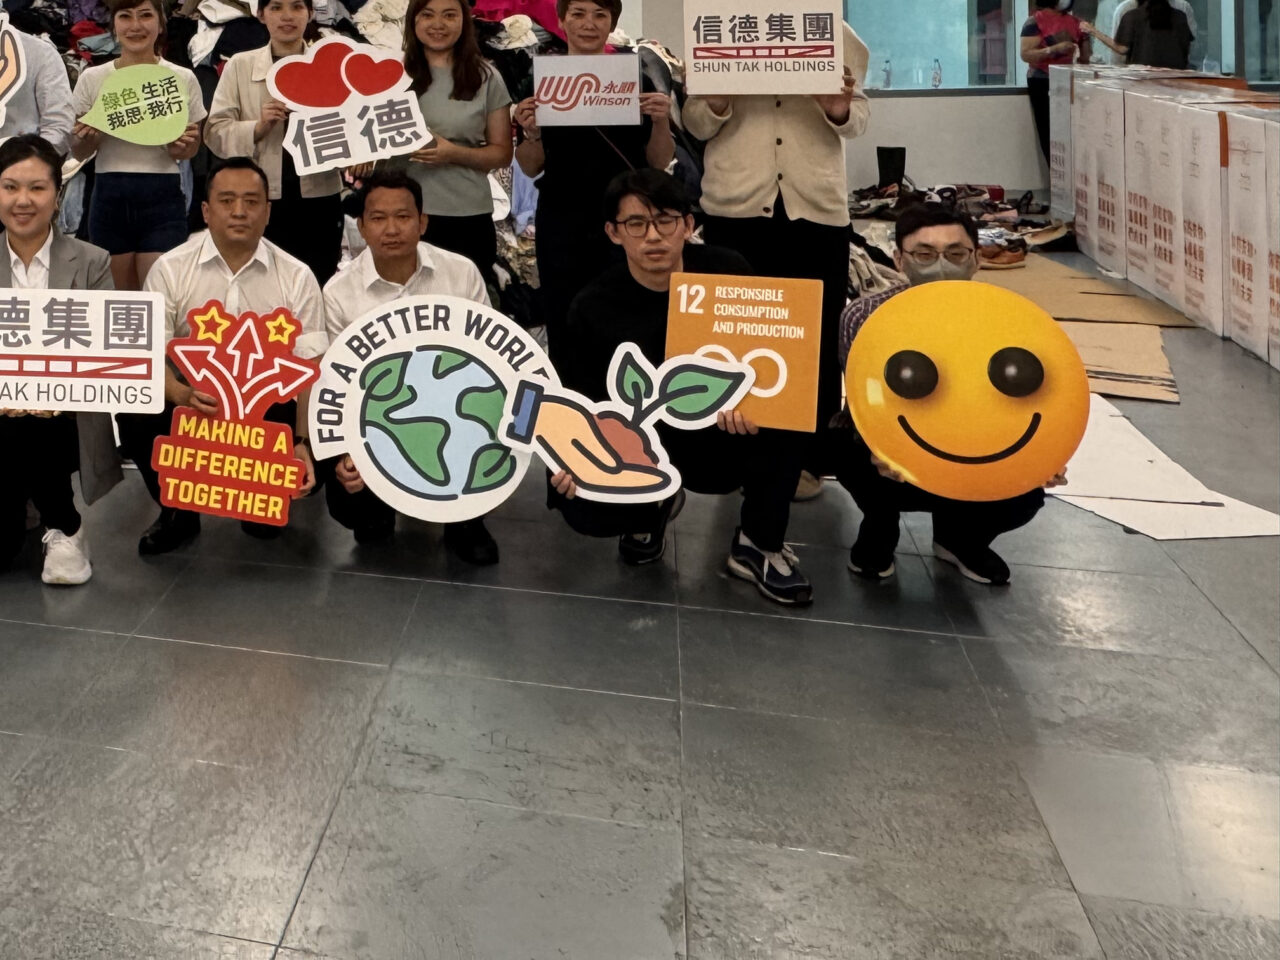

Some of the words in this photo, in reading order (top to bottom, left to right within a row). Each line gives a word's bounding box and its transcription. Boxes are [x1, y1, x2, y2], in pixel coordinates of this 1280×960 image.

[693, 12, 834, 44] 信德集團
[693, 61, 730, 73] SHUN
[735, 60, 759, 72] TAK
[764, 60, 835, 72] HOLDINGS
[583, 95, 631, 106] Winson
[292, 99, 422, 167] 信德
[677, 283, 706, 314] 12
[715, 286, 784, 302] RESPONSIBLE
[713, 303, 789, 320] CONSUMPTION
[345, 304, 451, 362] BETTER
[712, 321, 734, 334] AND
[736, 322, 805, 339] PRODUCTION
[330, 361, 357, 384] A
[37, 383, 153, 405] HOLDINGS
[316, 388, 346, 443] FOR
[177, 414, 265, 449] MAKING
[272, 431, 287, 454] A
[158, 443, 298, 488] DIFFERENCE
[165, 477, 283, 519] TOGETHER
